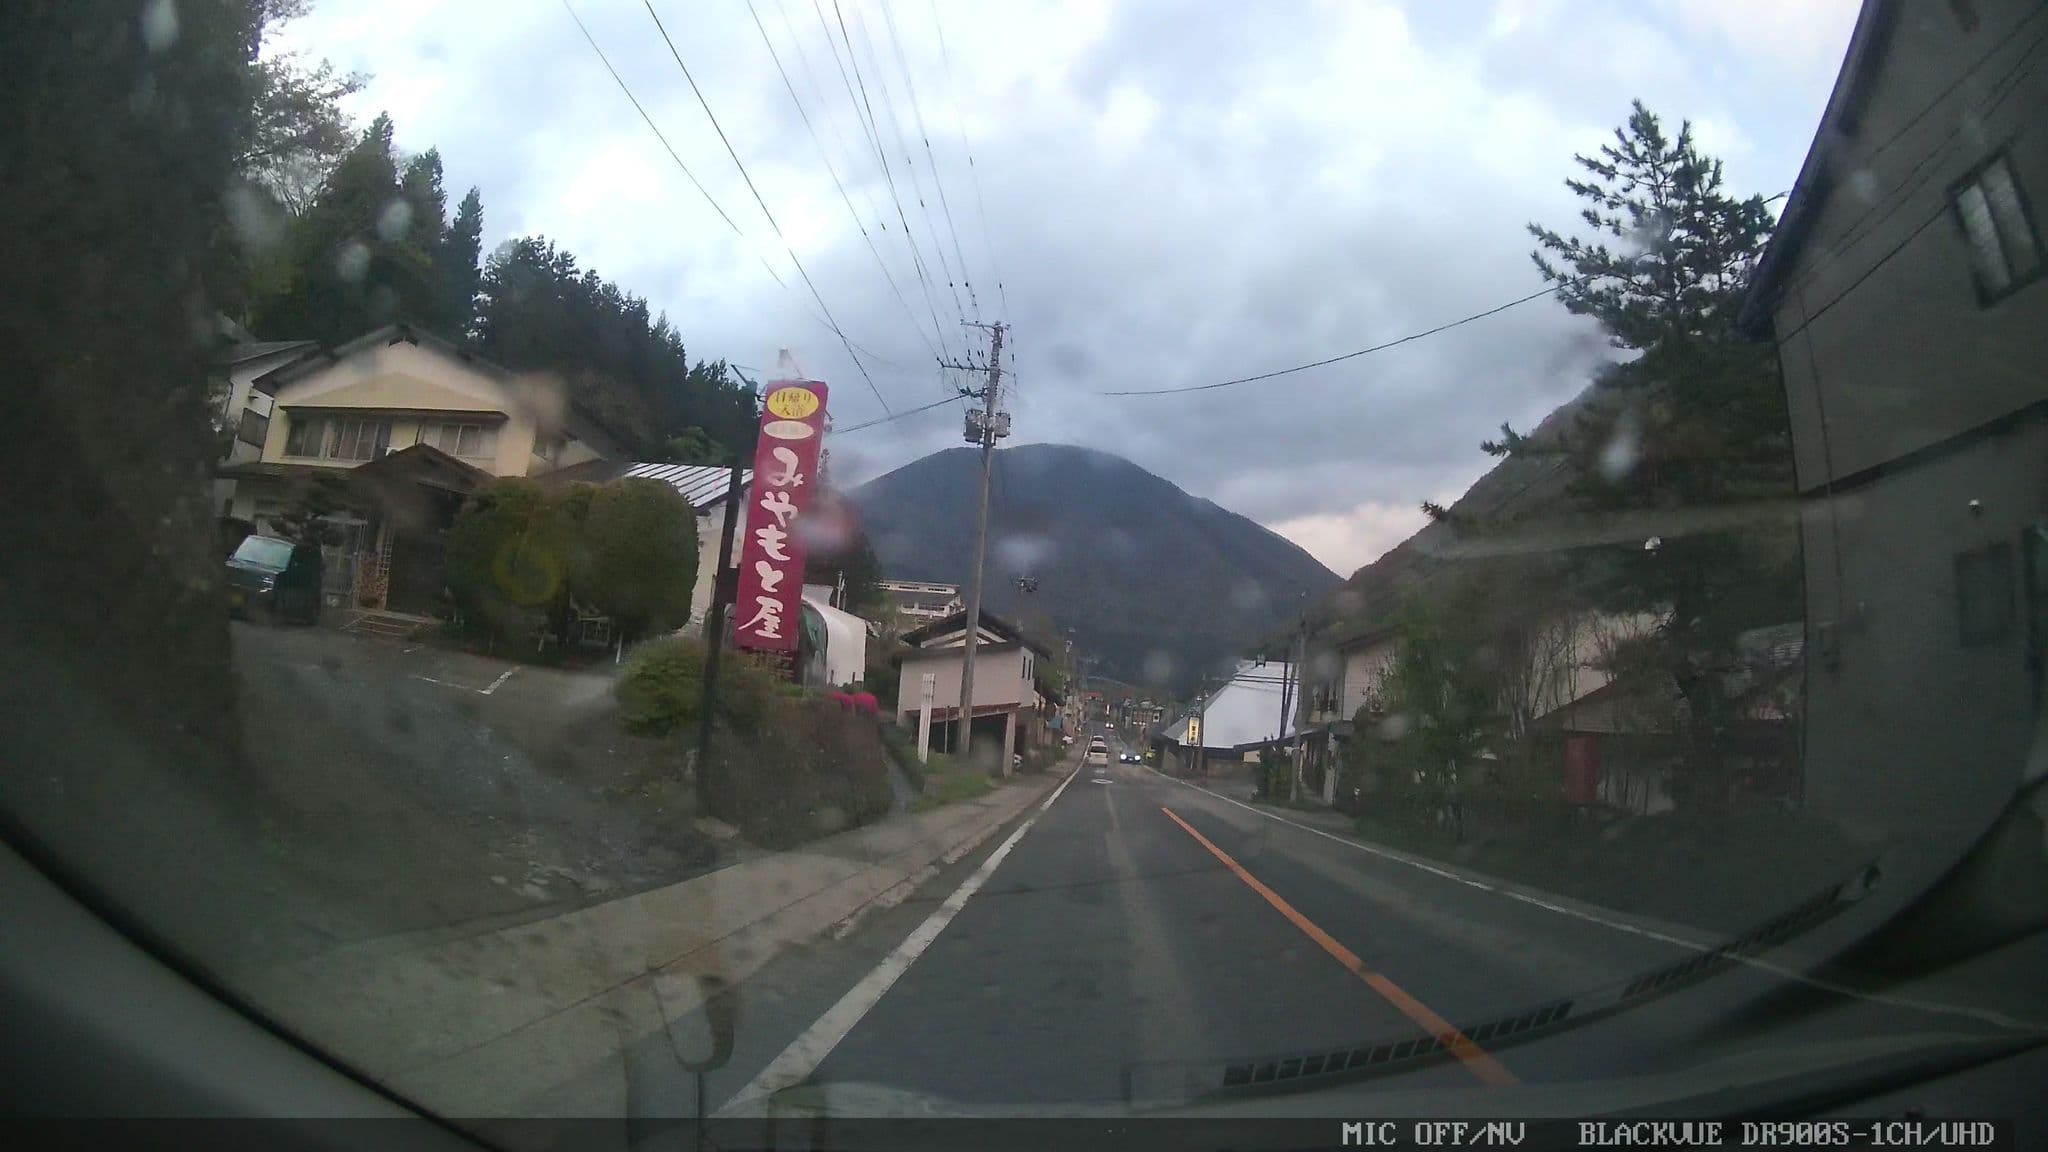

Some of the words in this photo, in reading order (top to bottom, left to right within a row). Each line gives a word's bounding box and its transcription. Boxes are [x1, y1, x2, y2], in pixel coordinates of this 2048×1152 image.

[738, 446, 804, 640] みやもと屋
